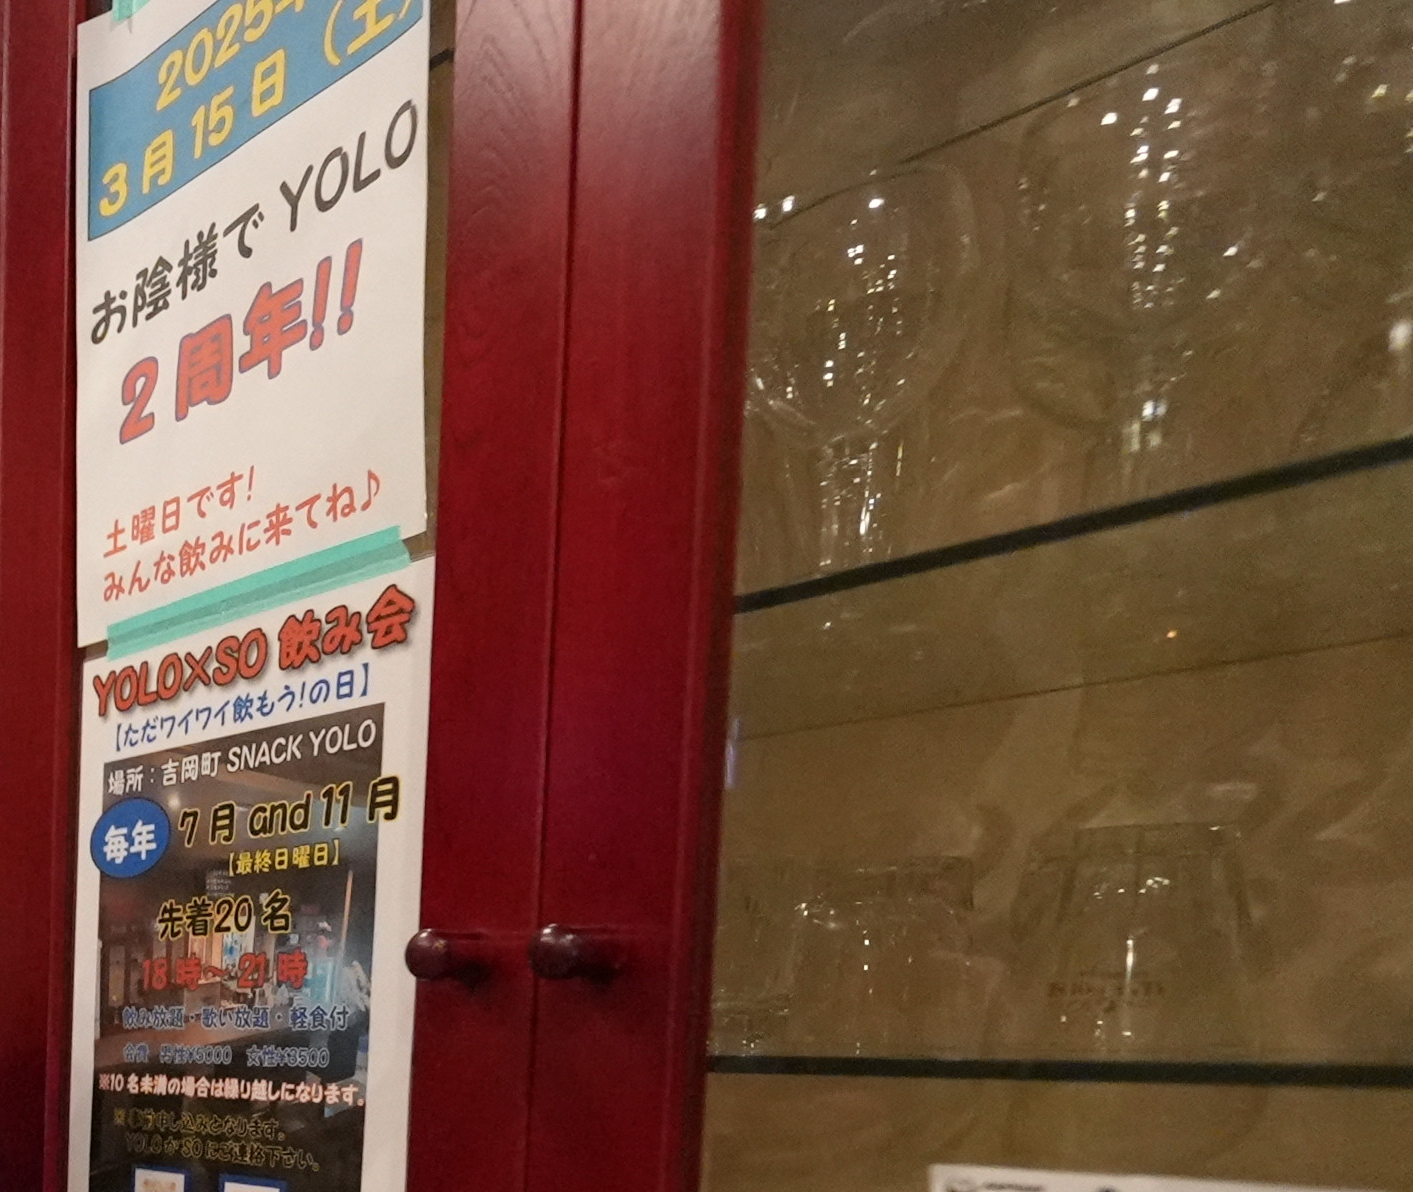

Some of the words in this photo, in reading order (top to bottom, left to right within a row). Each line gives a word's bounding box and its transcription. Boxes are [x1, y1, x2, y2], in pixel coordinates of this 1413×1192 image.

[91, 203, 265, 345] お陰様で
[279, 99, 419, 232] YOLO
[278, 583, 415, 671] 飲み会
[226, 734, 303, 773] SNACK
[308, 718, 376, 757] YOLO
[102, 819, 158, 865] 毎年
[248, 791, 311, 840] and
[157, 889, 292, 941] 先着20名
